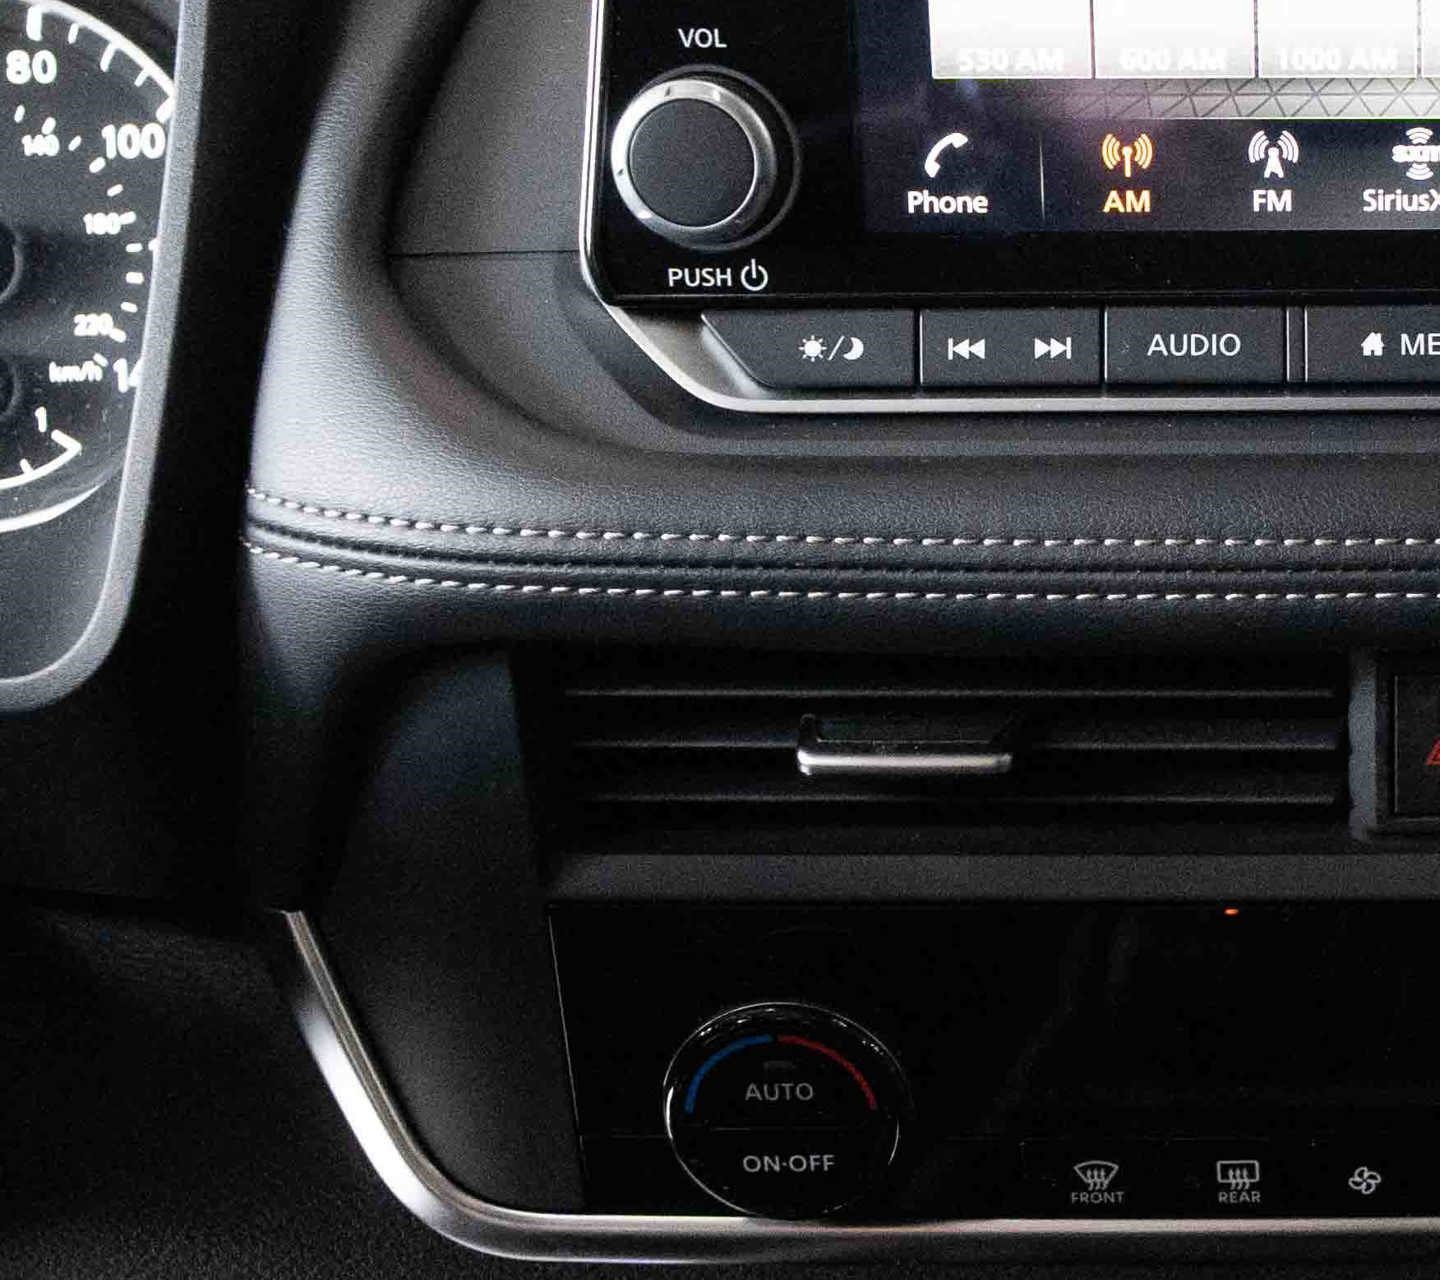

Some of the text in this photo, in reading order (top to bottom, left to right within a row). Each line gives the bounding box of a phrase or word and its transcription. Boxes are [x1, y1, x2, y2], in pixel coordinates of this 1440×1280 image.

[678, 28, 727, 48] VOL
[7, 50, 56, 85] 80
[1016, 48, 1062, 72] AM
[1178, 48, 1227, 72] AM
[1348, 48, 1397, 71] AM
[102, 124, 165, 158] 100
[907, 190, 988, 214] Phone
[1103, 191, 1152, 212] AM
[1252, 191, 1292, 212] FM
[668, 268, 731, 287] PUSH
[1147, 333, 1241, 357] AUDIO
[35, 407, 48, 433] 1
[745, 1083, 814, 1102] AUTO
[1070, 1192, 1125, 1205] FRONT
[1218, 1191, 1261, 1203] REAR
